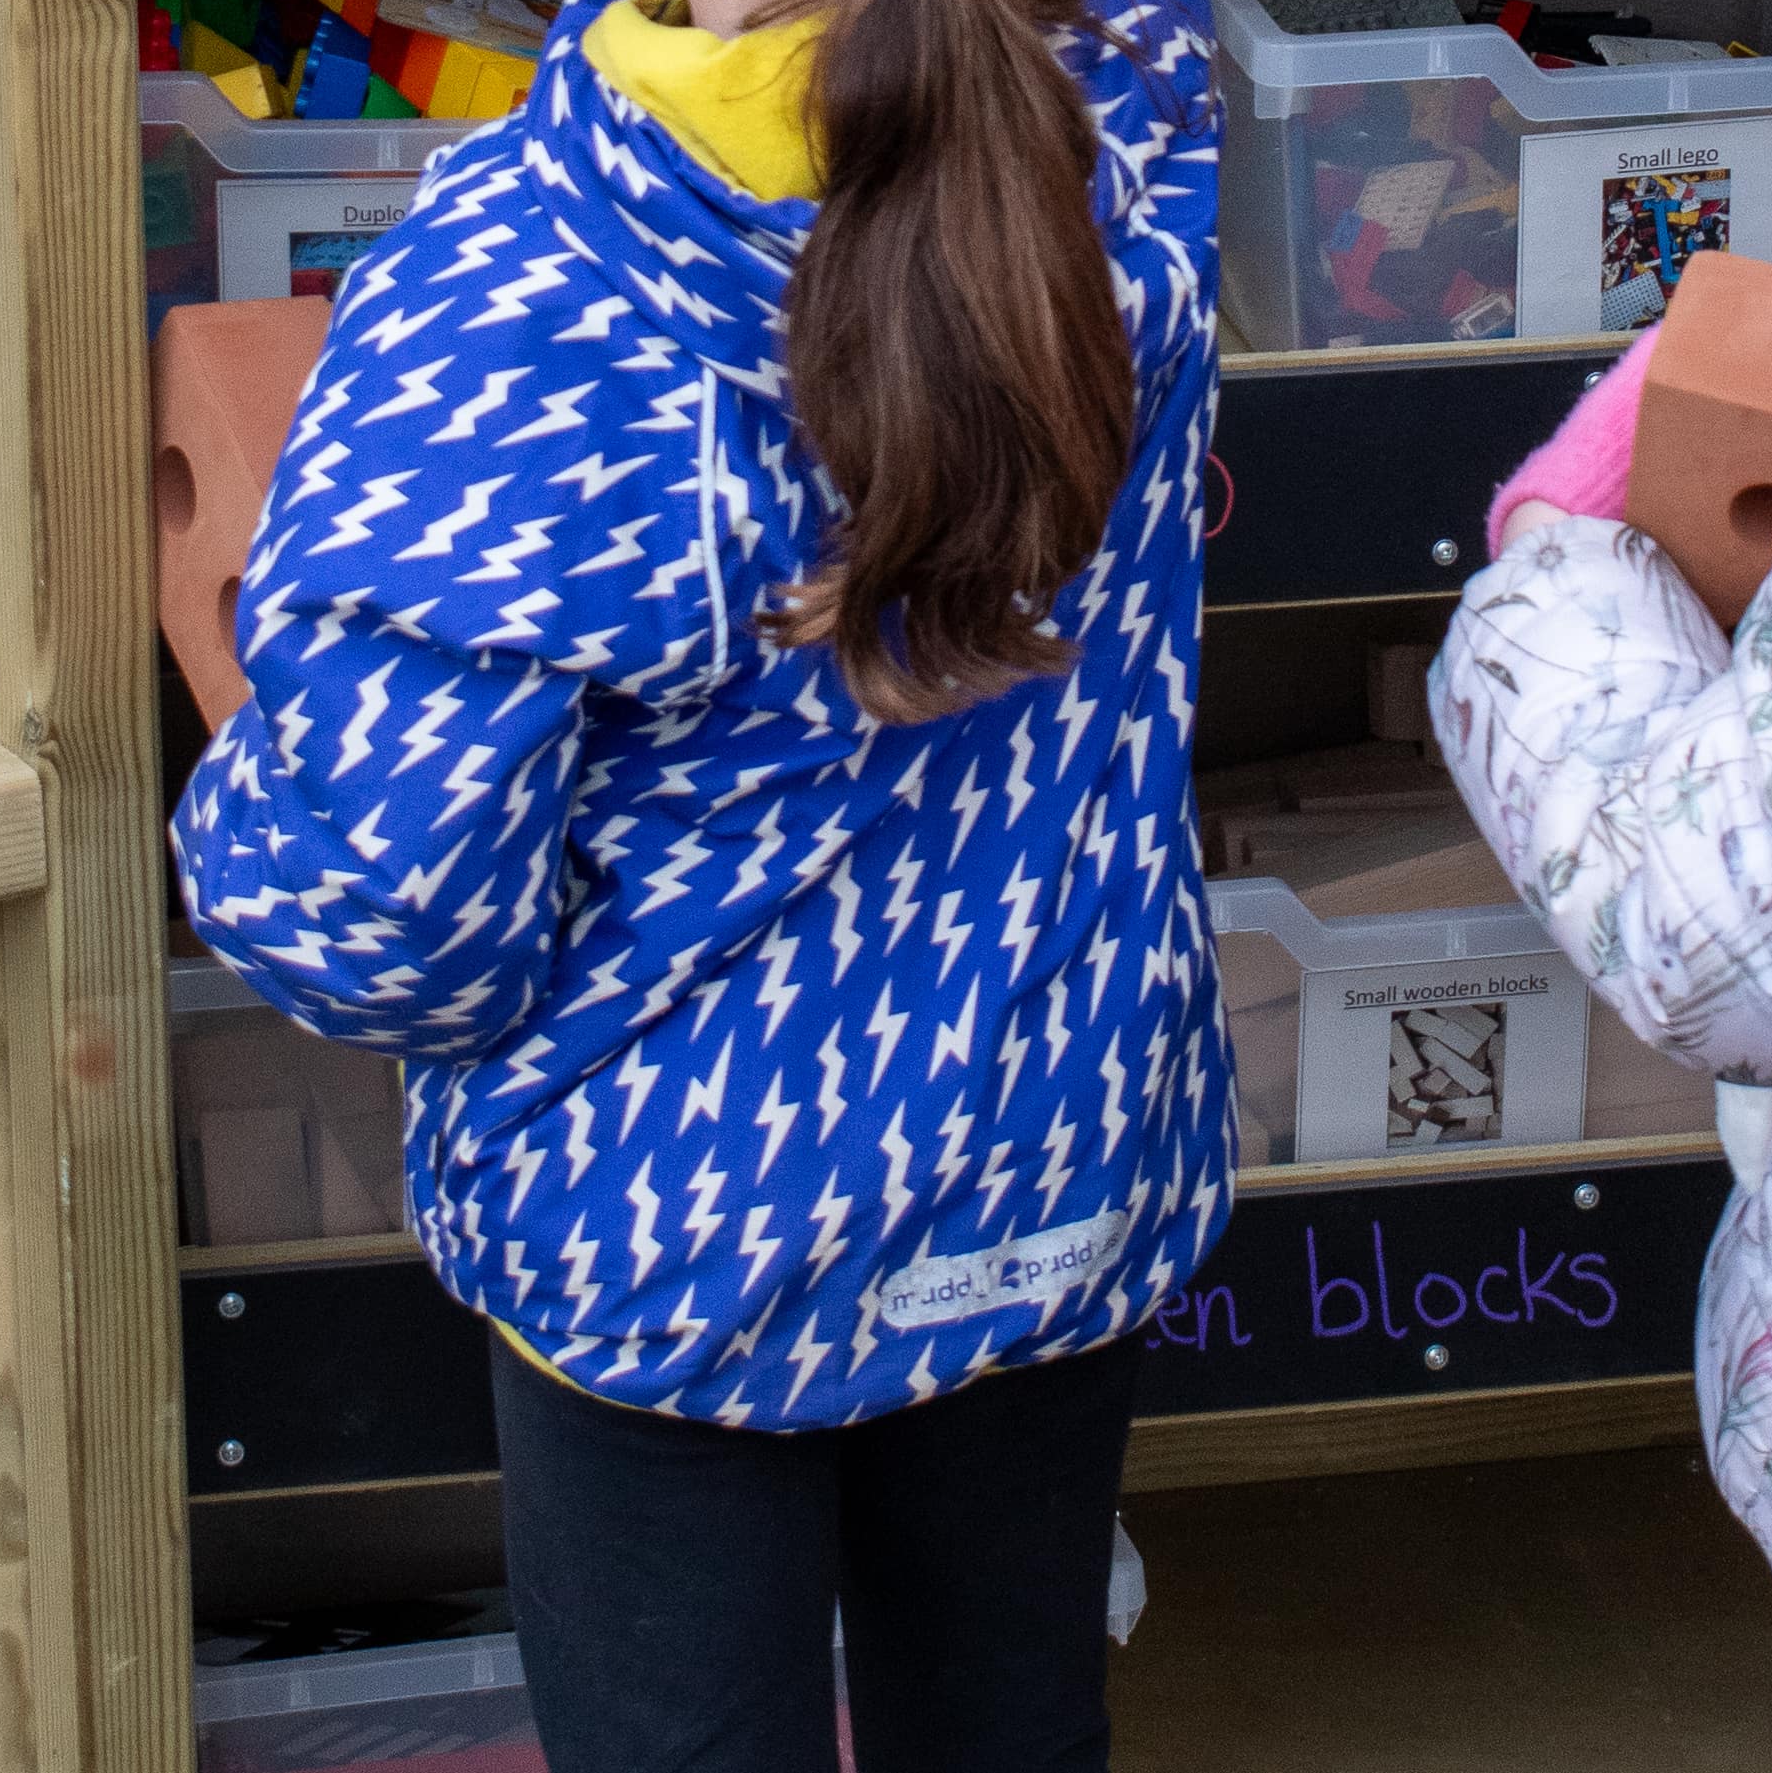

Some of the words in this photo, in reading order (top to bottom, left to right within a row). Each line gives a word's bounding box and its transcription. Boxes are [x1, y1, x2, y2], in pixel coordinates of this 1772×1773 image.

[1618, 147, 1671, 169] Small
[1678, 147, 1718, 166] lego
[344, 205, 405, 225] Duplo
[1344, 985, 1397, 1006] Small
[1404, 980, 1481, 1001] wooden
[1488, 974, 1548, 994] blocks
[1306, 1220, 1619, 1340] blocks
